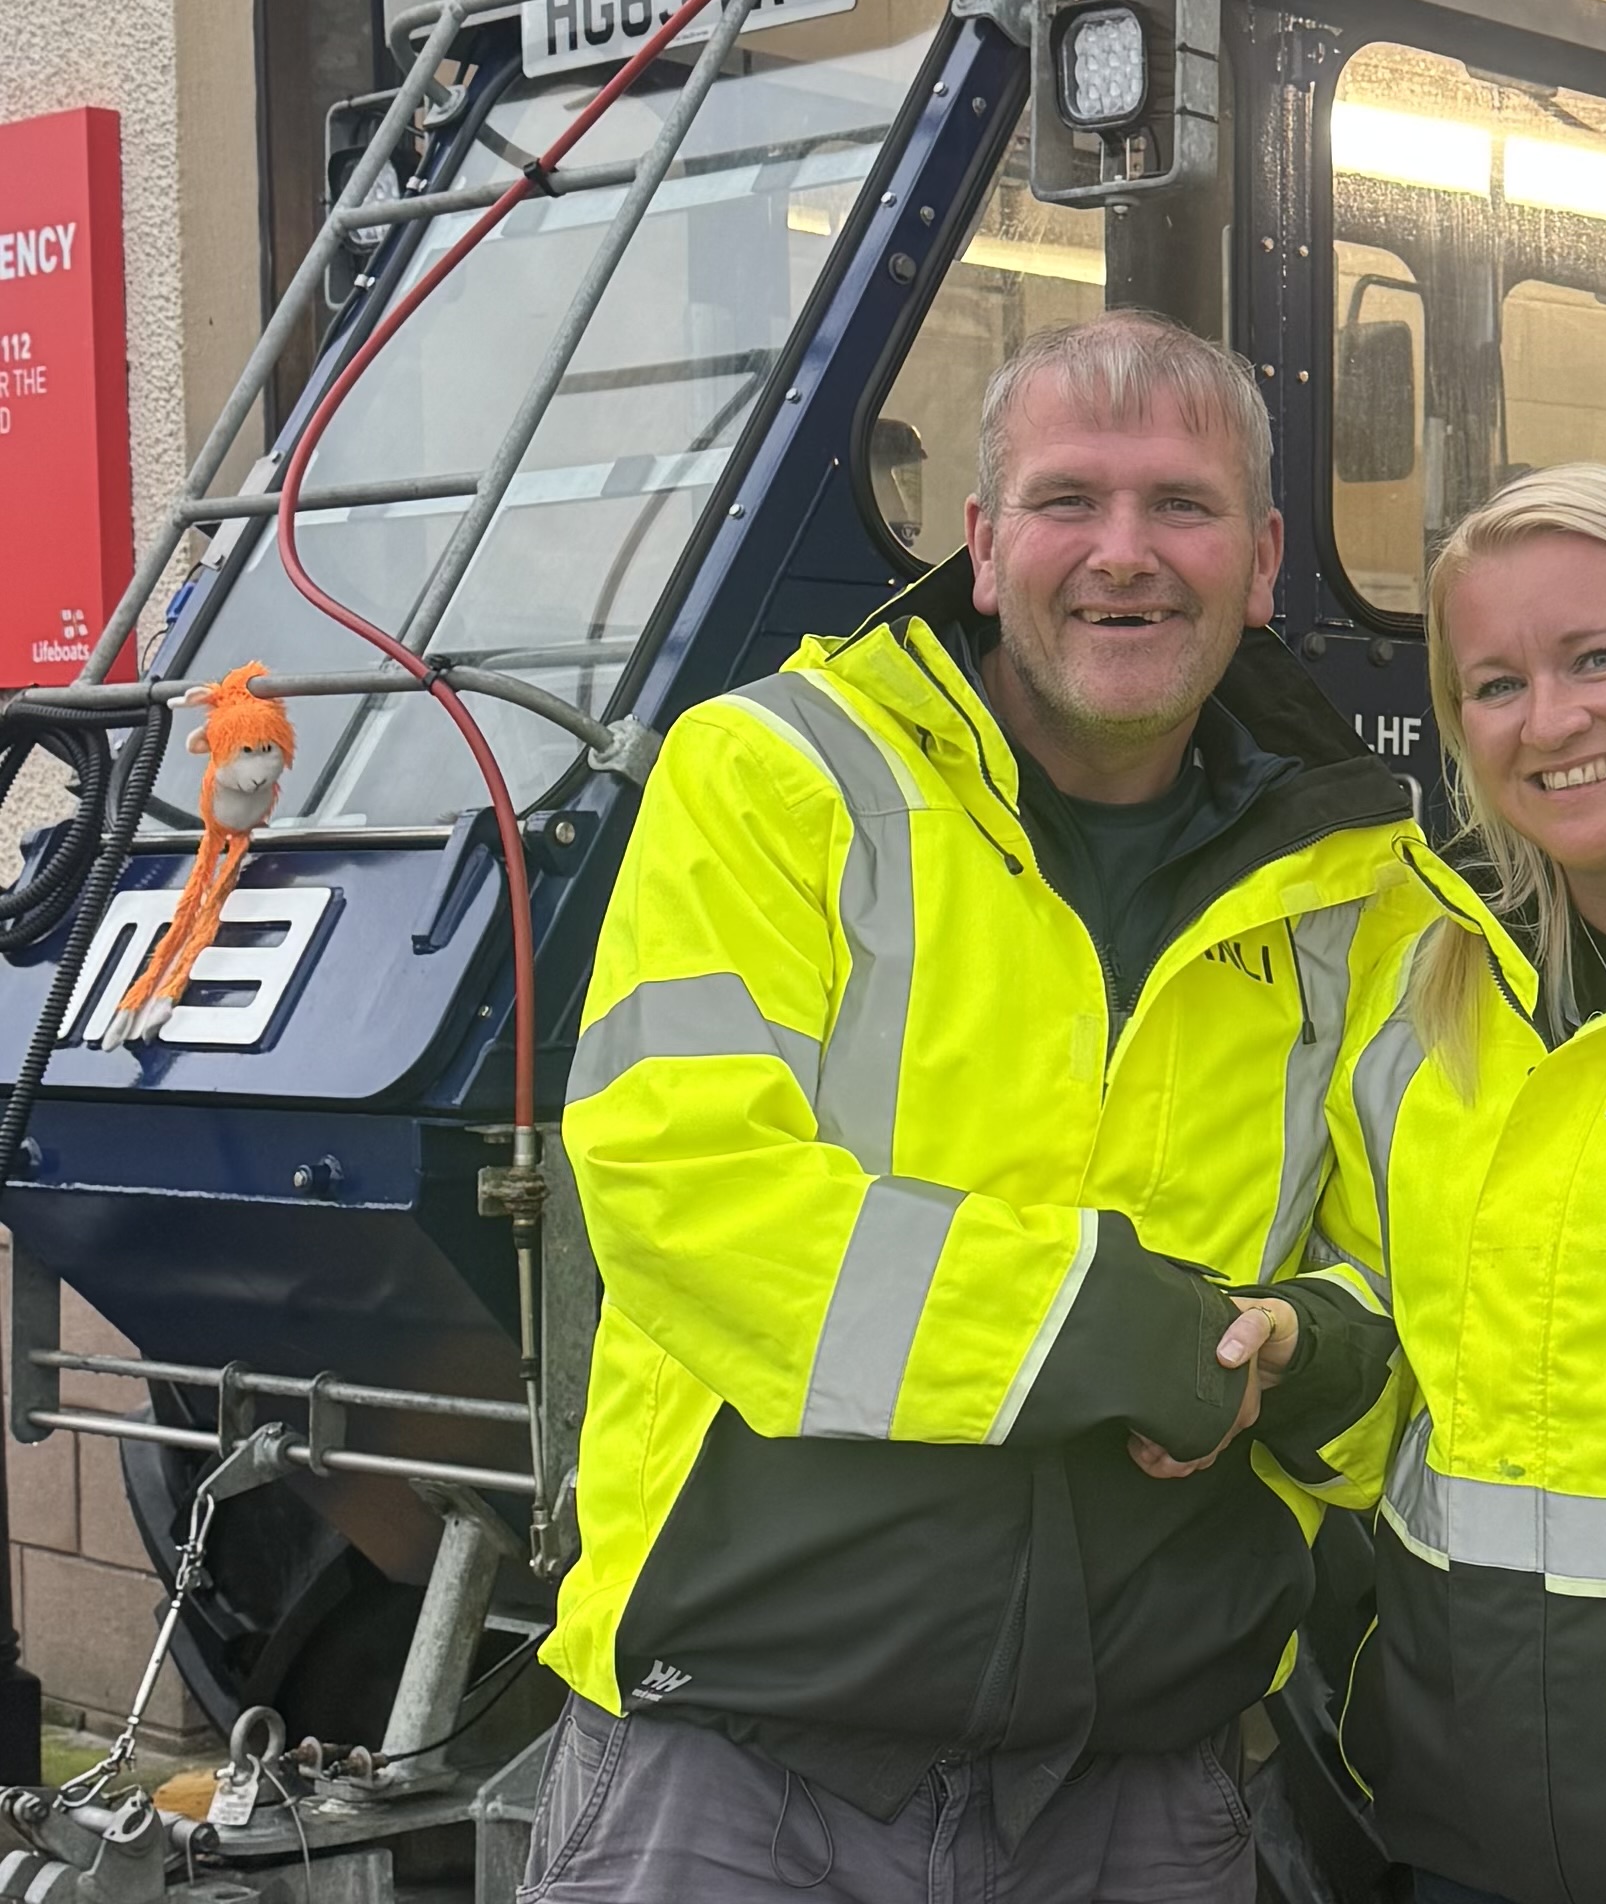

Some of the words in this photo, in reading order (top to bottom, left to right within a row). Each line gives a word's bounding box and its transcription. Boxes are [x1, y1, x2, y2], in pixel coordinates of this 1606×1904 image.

[1, 332, 31, 363] 112
[13, 365, 47, 397] THE
[32, 639, 90, 663] Lifeboats
[1203, 940, 1274, 985] NLI
